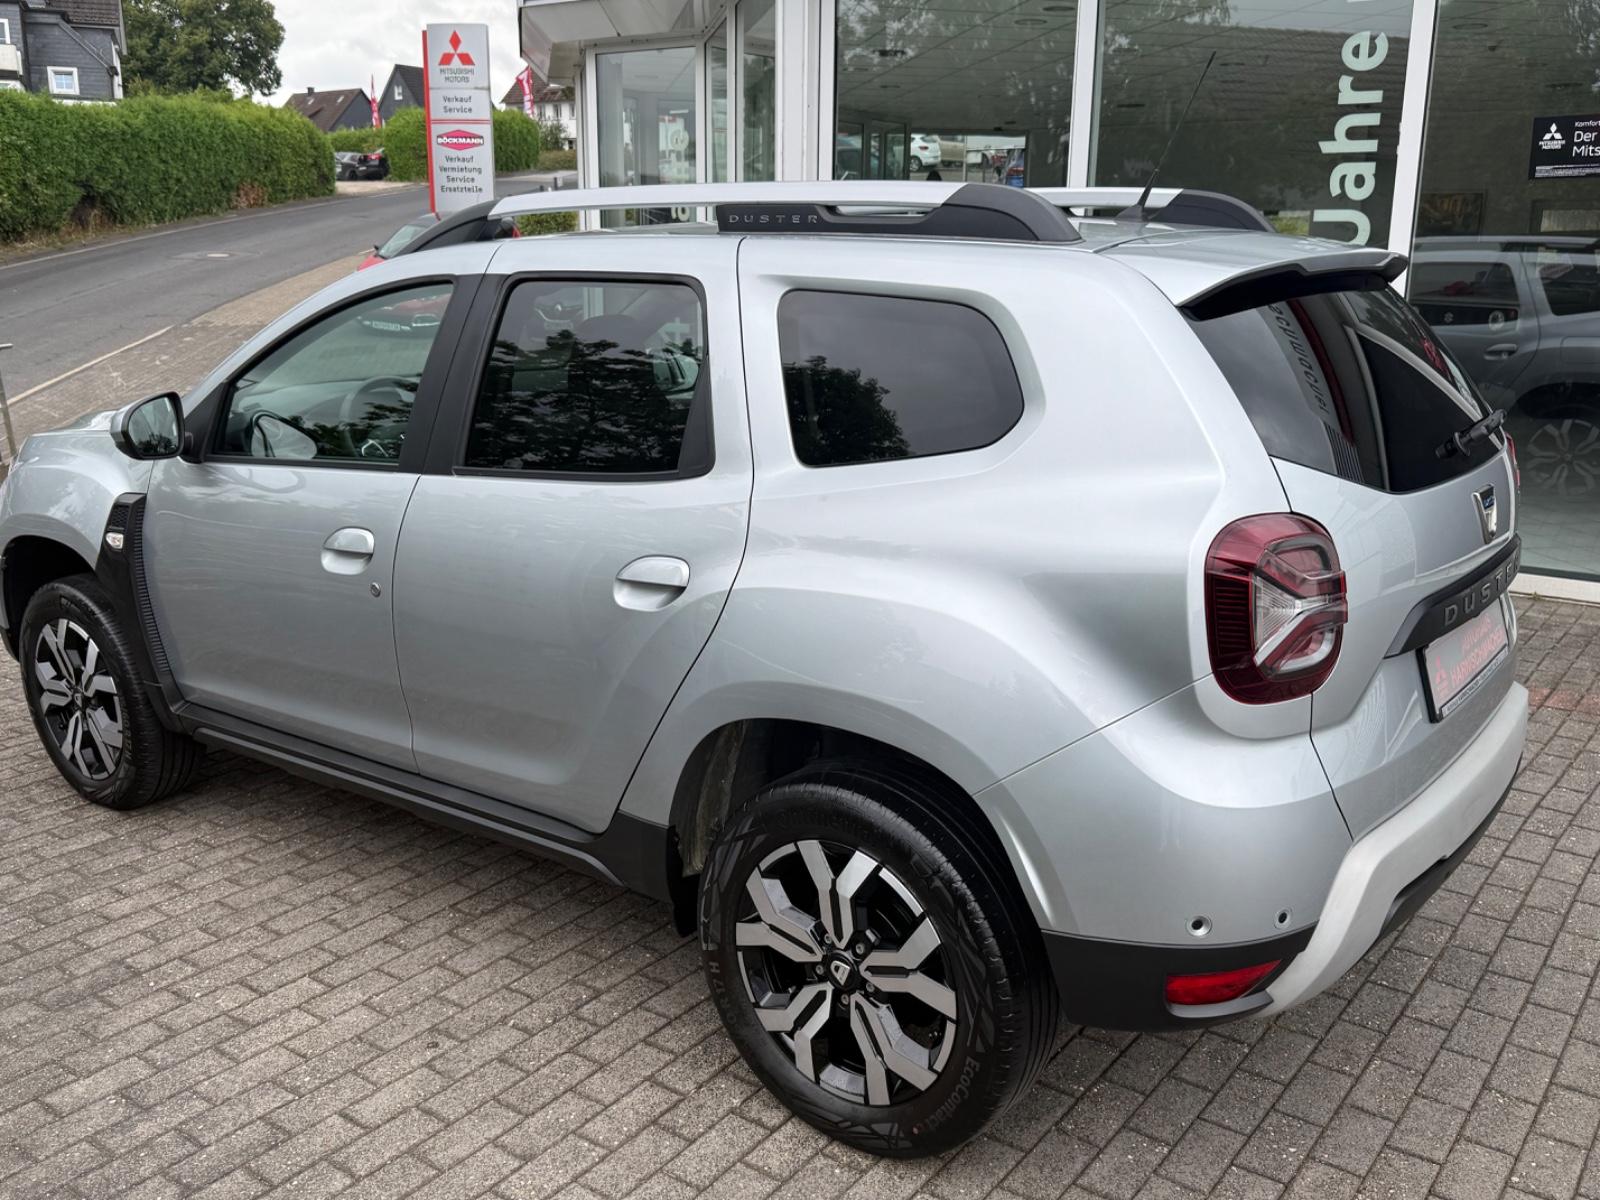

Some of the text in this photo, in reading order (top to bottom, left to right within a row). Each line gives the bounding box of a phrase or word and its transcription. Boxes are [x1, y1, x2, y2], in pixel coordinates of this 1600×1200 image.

[443, 95, 472, 103] Verkauf
[1574, 131, 1598, 143] Der
[445, 155, 474, 163] Verkauf
[439, 166, 482, 175] Vermietung
[440, 185, 483, 193] Ersatzteile
[728, 214, 819, 224] DUSTER
